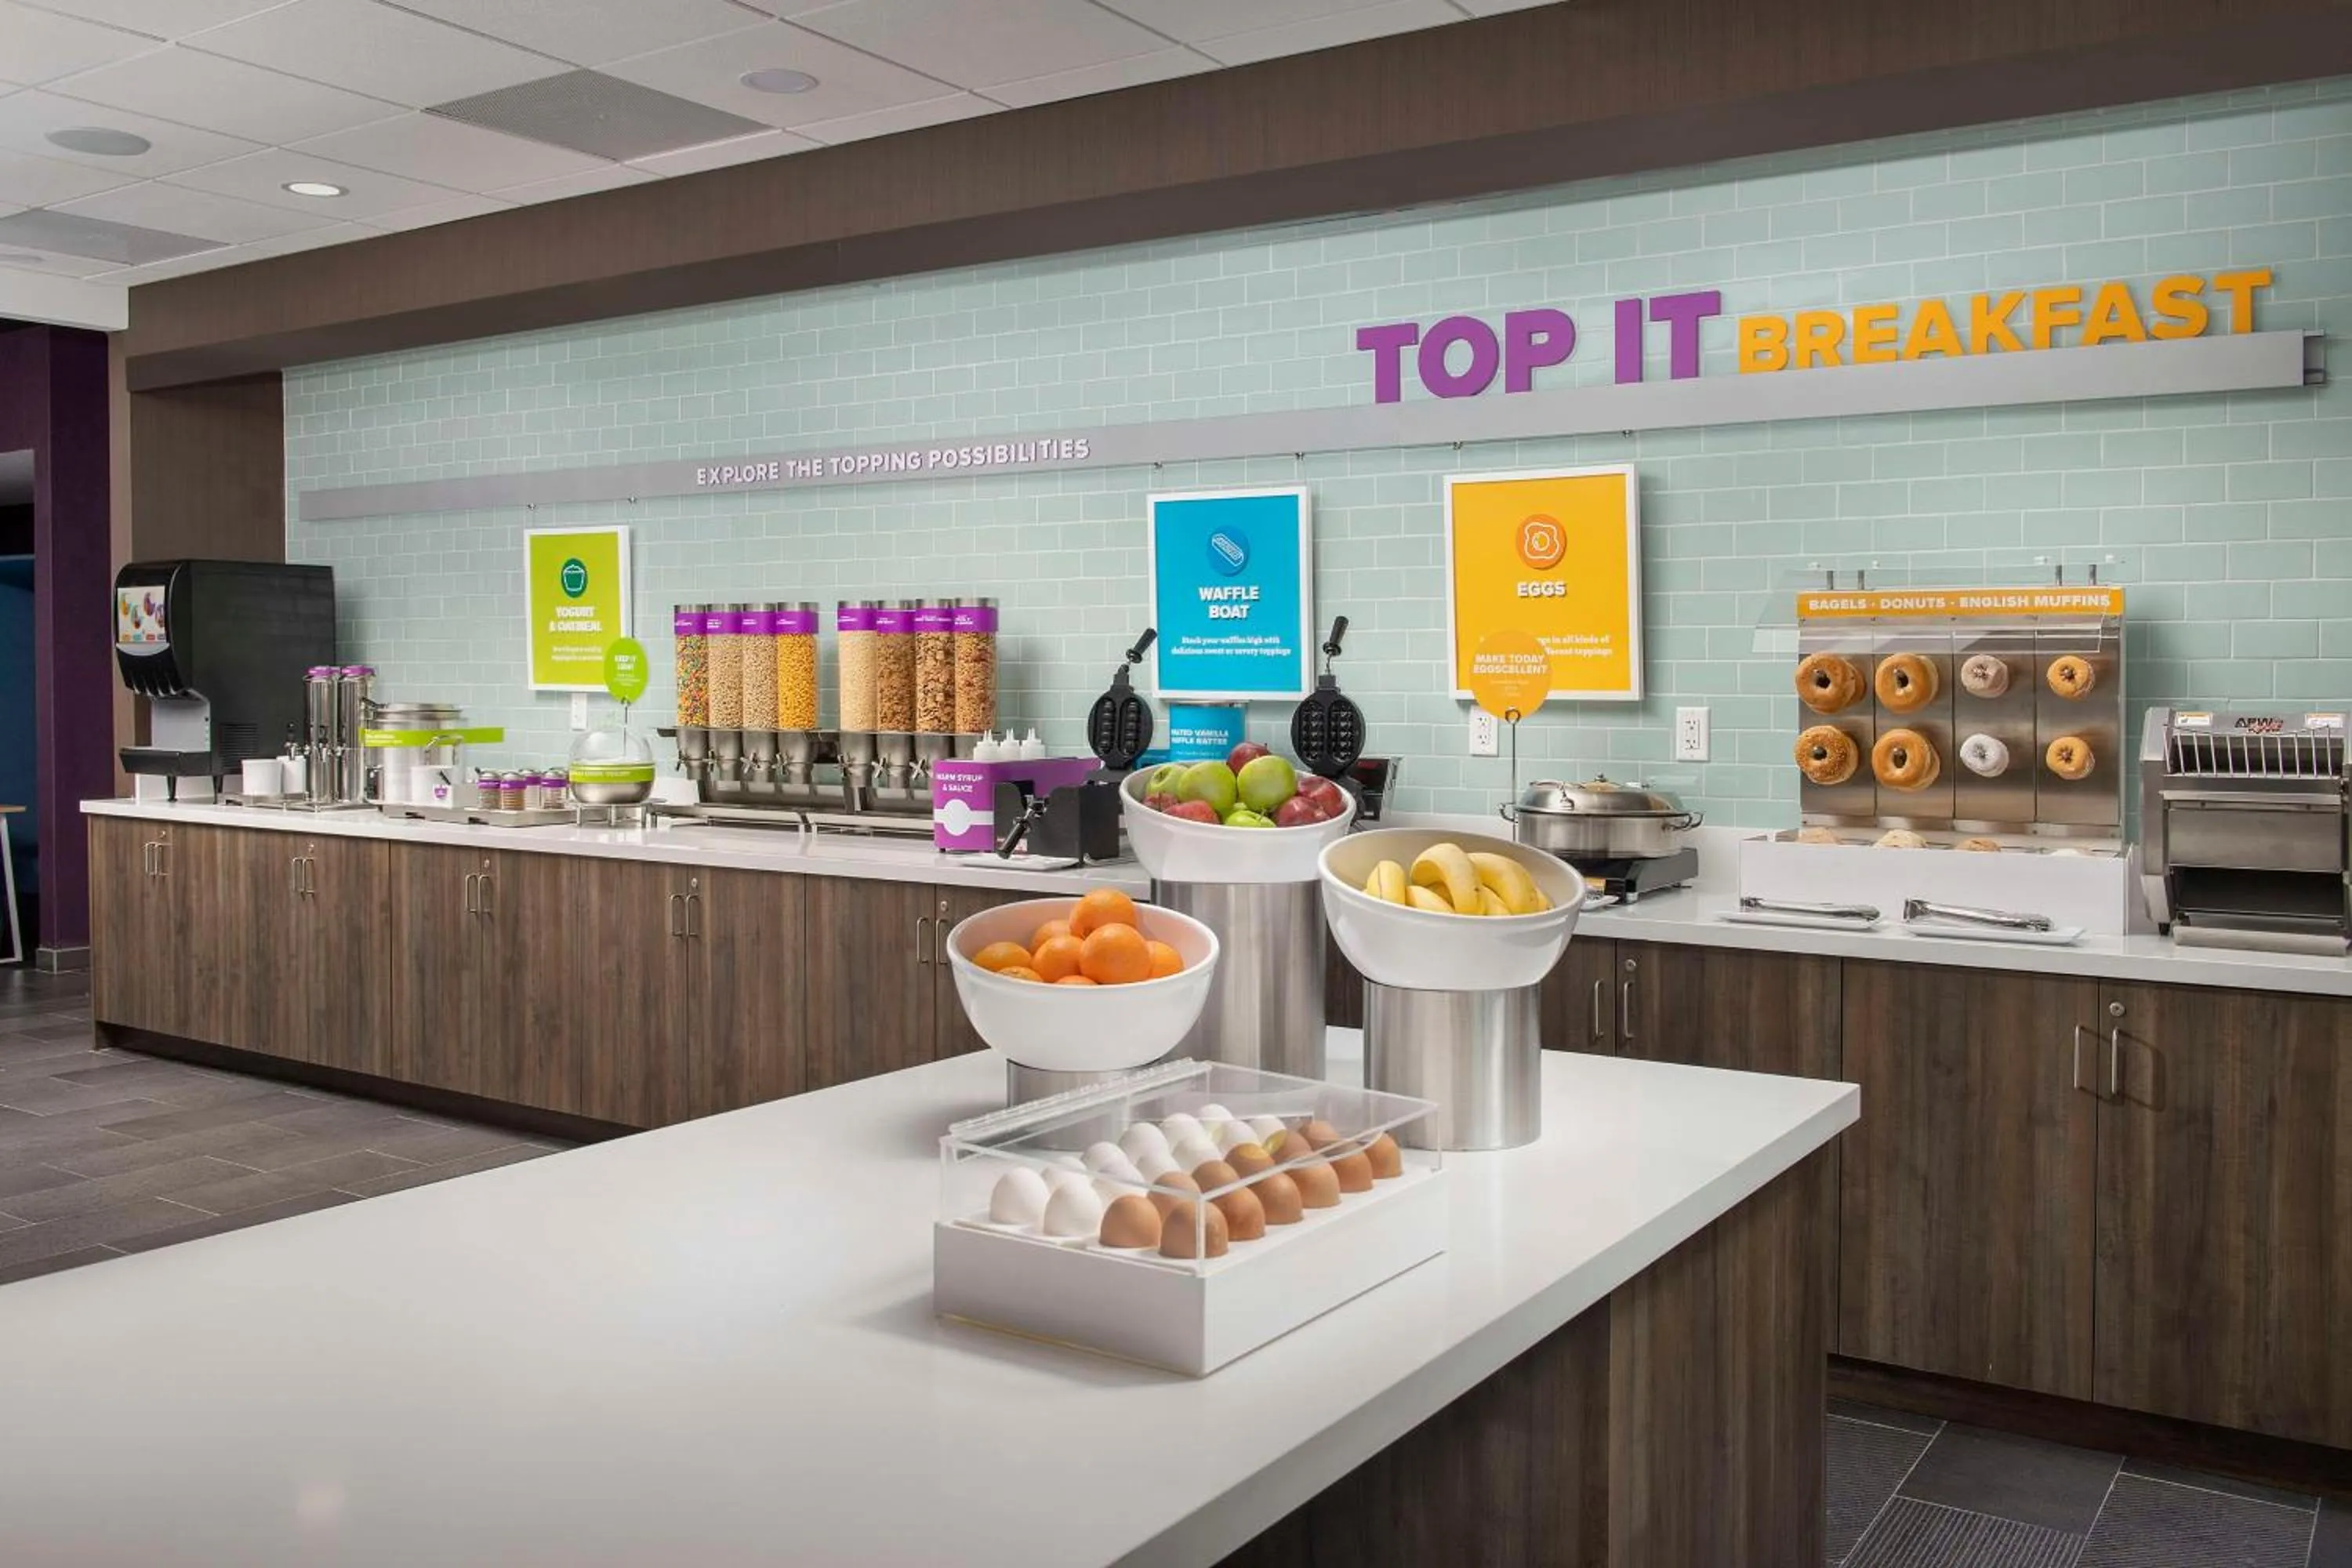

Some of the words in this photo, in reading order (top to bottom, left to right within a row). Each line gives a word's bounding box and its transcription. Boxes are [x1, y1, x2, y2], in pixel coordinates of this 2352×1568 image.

[1356, 308, 1577, 404] TOP
[1614, 289, 1722, 384] IT
[1738, 268, 2272, 375] BREAKFAST
[696, 461, 780, 486] EXPLORE
[786, 457, 823, 480] THE
[829, 451, 923, 476] TOPPING
[927, 437, 1091, 469] POSSIBILITIES
[1198, 586, 1260, 602] WAFFLE
[1516, 580, 1567, 597] EGGS
[1809, 598, 1867, 611] BAGELS
[1880, 597, 1946, 609] DONUTS
[1959, 595, 2030, 608] ENGLISH
[2034, 593, 2111, 608] MUFFINS
[1208, 604, 1250, 619] BOAT
[1475, 654, 1505, 664] MAKE
[1509, 653, 1544, 665] TODAY
[1473, 663, 1548, 675] EGGSCELLENT
[957, 774, 983, 782] SYRUP
